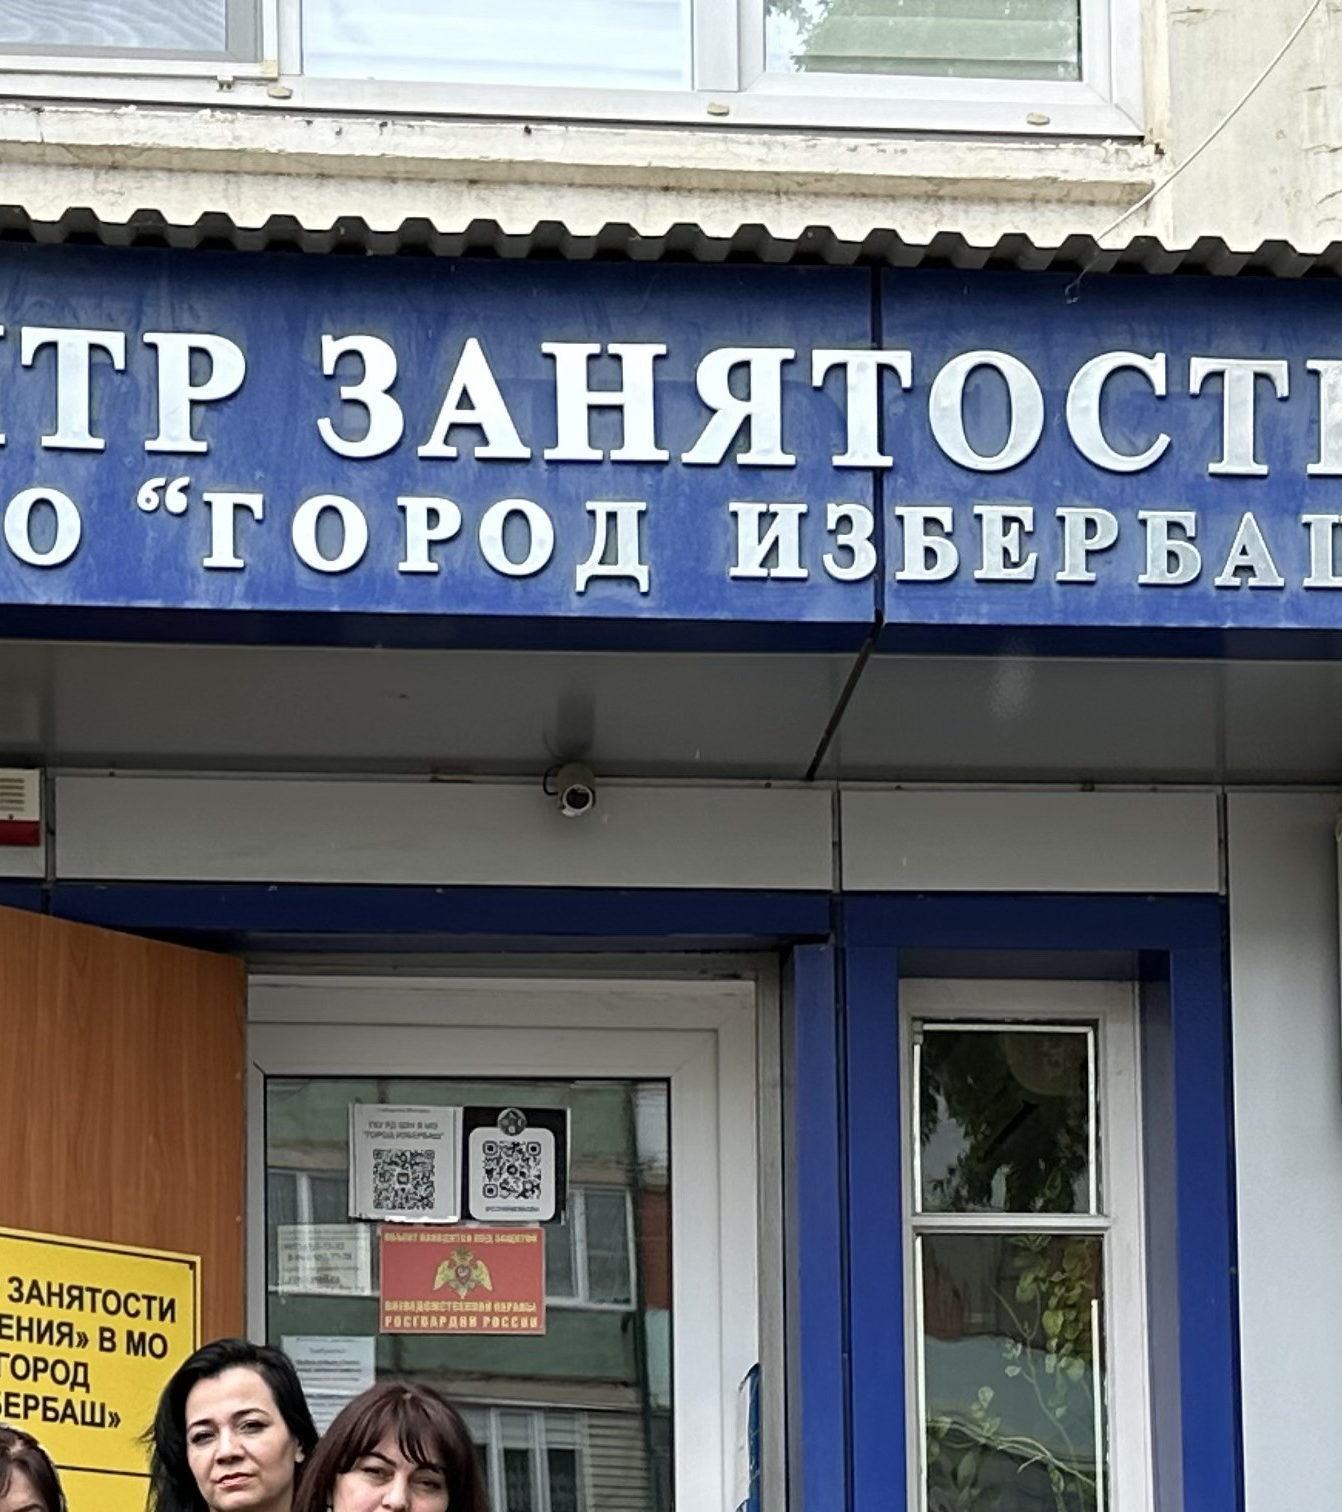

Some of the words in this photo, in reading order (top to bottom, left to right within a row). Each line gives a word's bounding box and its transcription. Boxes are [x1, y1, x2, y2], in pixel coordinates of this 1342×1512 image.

[7, 1276, 177, 1324] ЗАНЯТОСТИ
[98, 1327, 117, 1353] В
[125, 1331, 168, 1360] МО
